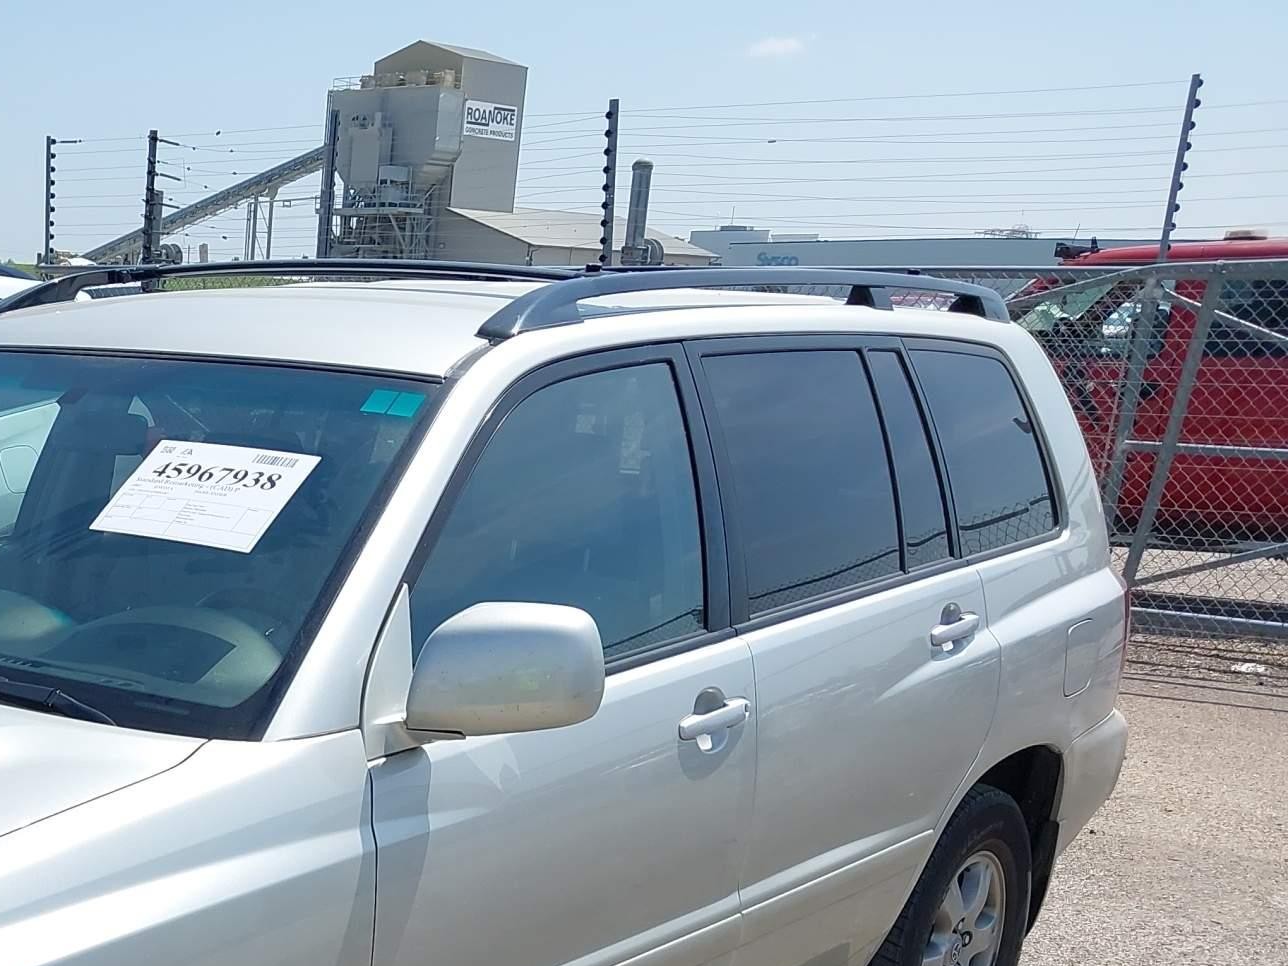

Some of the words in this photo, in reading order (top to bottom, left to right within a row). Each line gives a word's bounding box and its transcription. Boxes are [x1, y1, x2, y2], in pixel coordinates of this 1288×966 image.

[466, 107, 515, 126] ROANOKE
[465, 126, 489, 136] CONCRETE
[489, 129, 514, 139] PRODUCTS
[152, 462, 282, 490] 45967938
